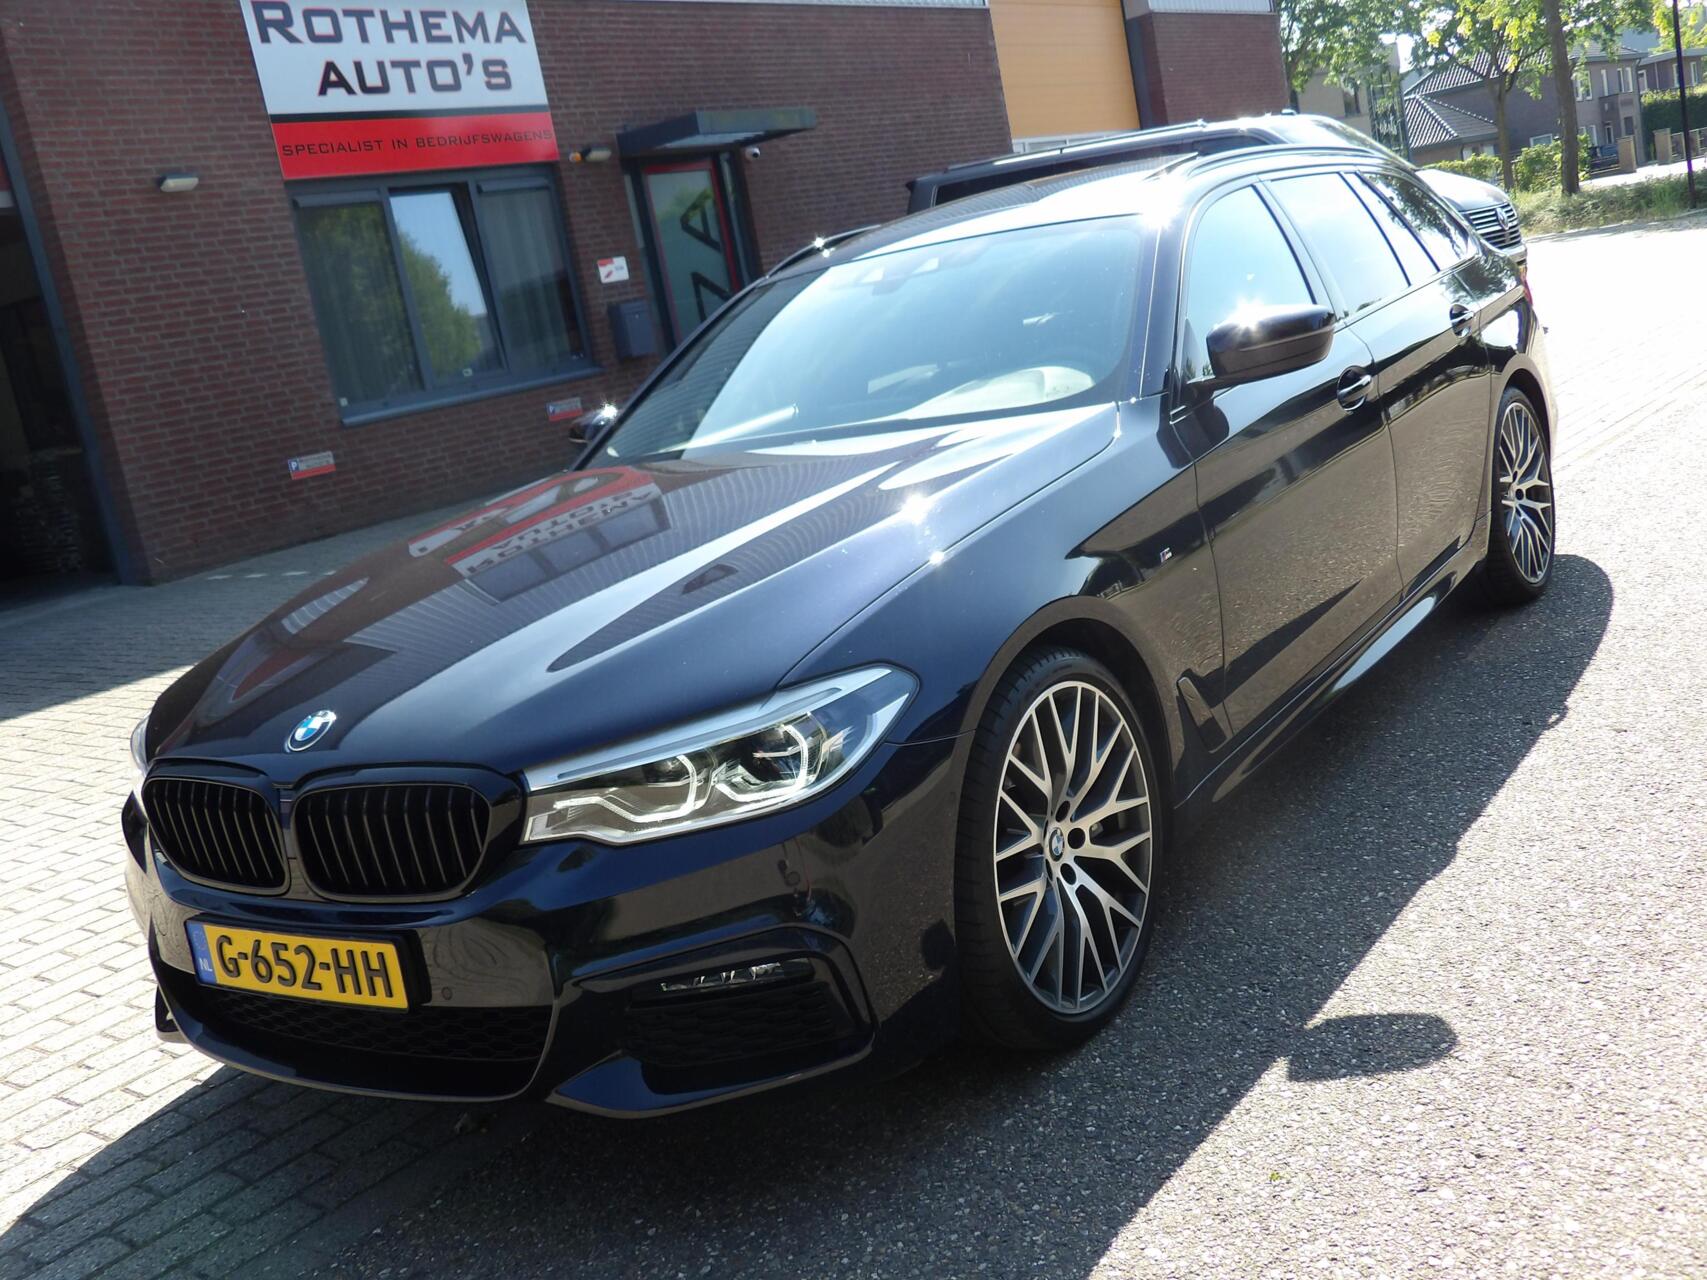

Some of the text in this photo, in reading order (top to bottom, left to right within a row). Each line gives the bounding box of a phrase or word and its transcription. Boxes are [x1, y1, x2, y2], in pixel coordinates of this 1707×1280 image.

[251, 0, 527, 44] ROTHEMA
[317, 52, 512, 96] AUTO'S
[281, 129, 553, 157] SPECIALIST IN BEDRIJFSWAGENS
[199, 957, 213, 972] NL
[216, 934, 394, 998] G-652-HH
